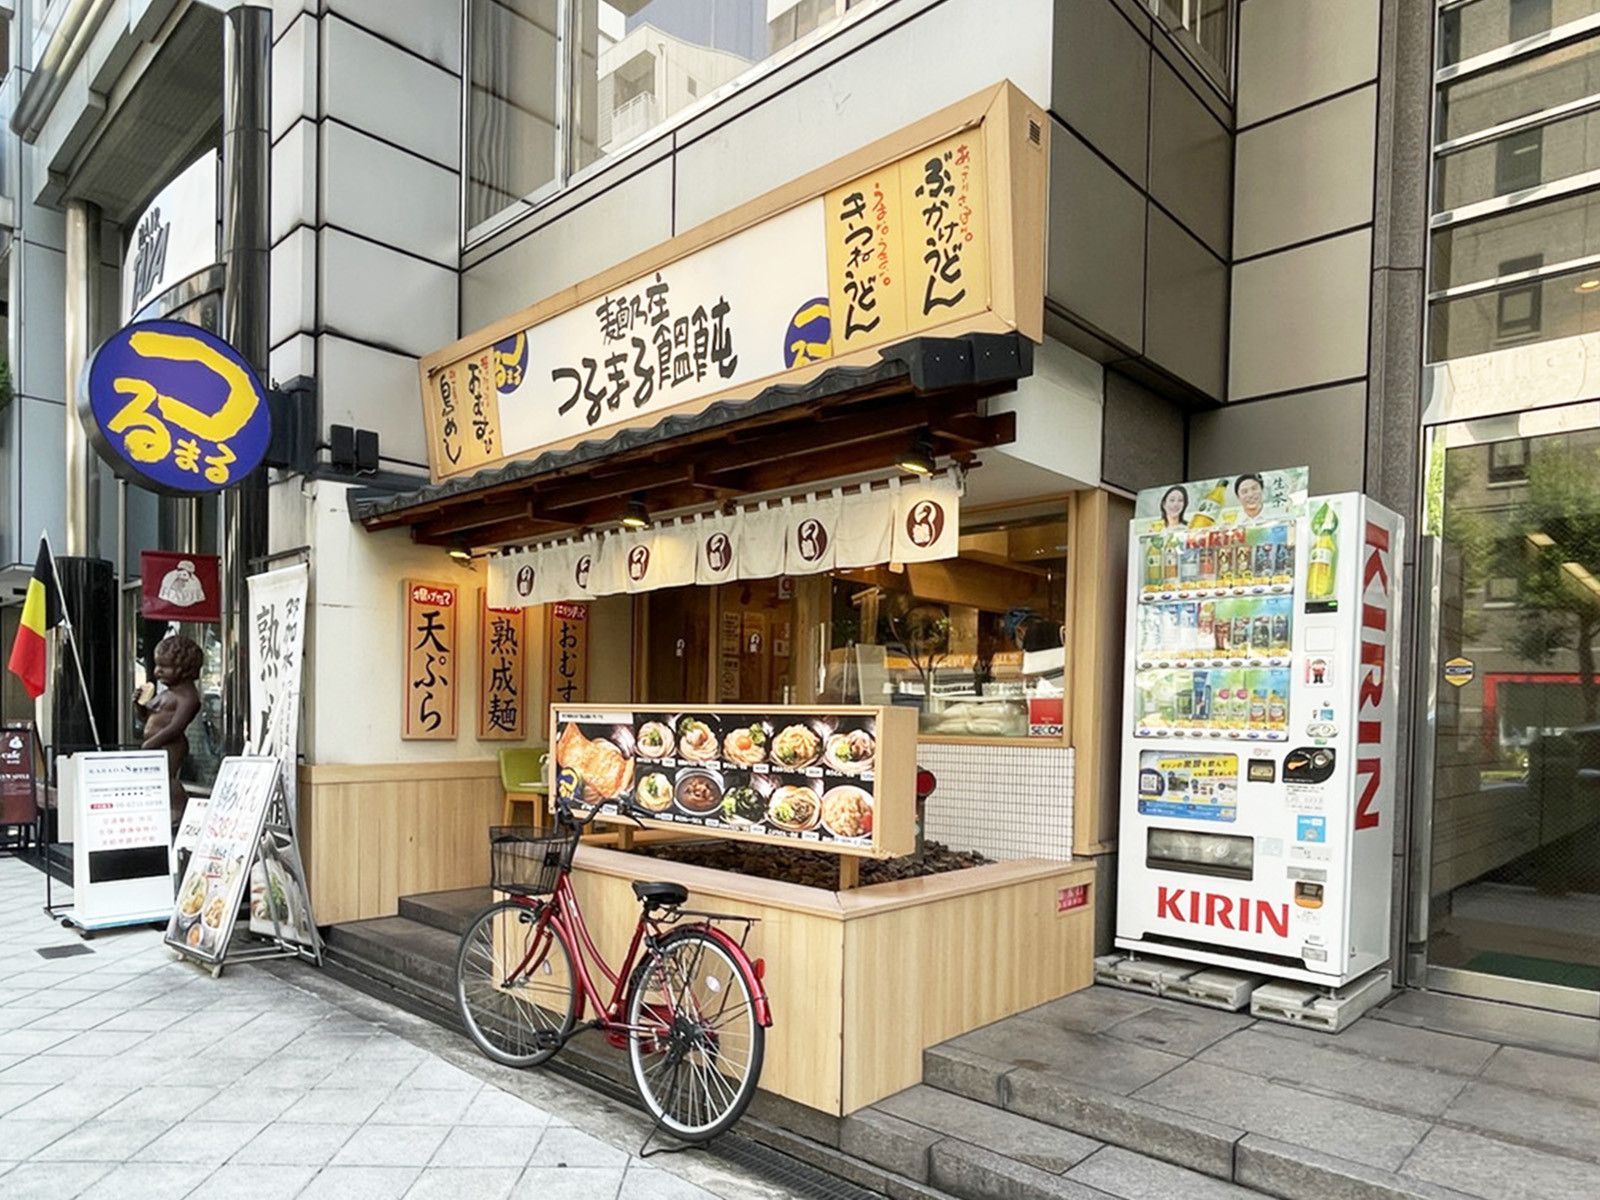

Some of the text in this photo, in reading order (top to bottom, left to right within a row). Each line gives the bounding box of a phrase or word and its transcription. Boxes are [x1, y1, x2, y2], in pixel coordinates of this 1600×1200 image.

[839, 192, 881, 340] きつねうどん
[915, 151, 966, 316] ぶっかけうどん
[414, 610, 450, 732] 天ぷら
[488, 616, 518, 732] 熟成麺
[1355, 521, 1389, 830] KIRIN
[1157, 886, 1289, 938] KIRIN
